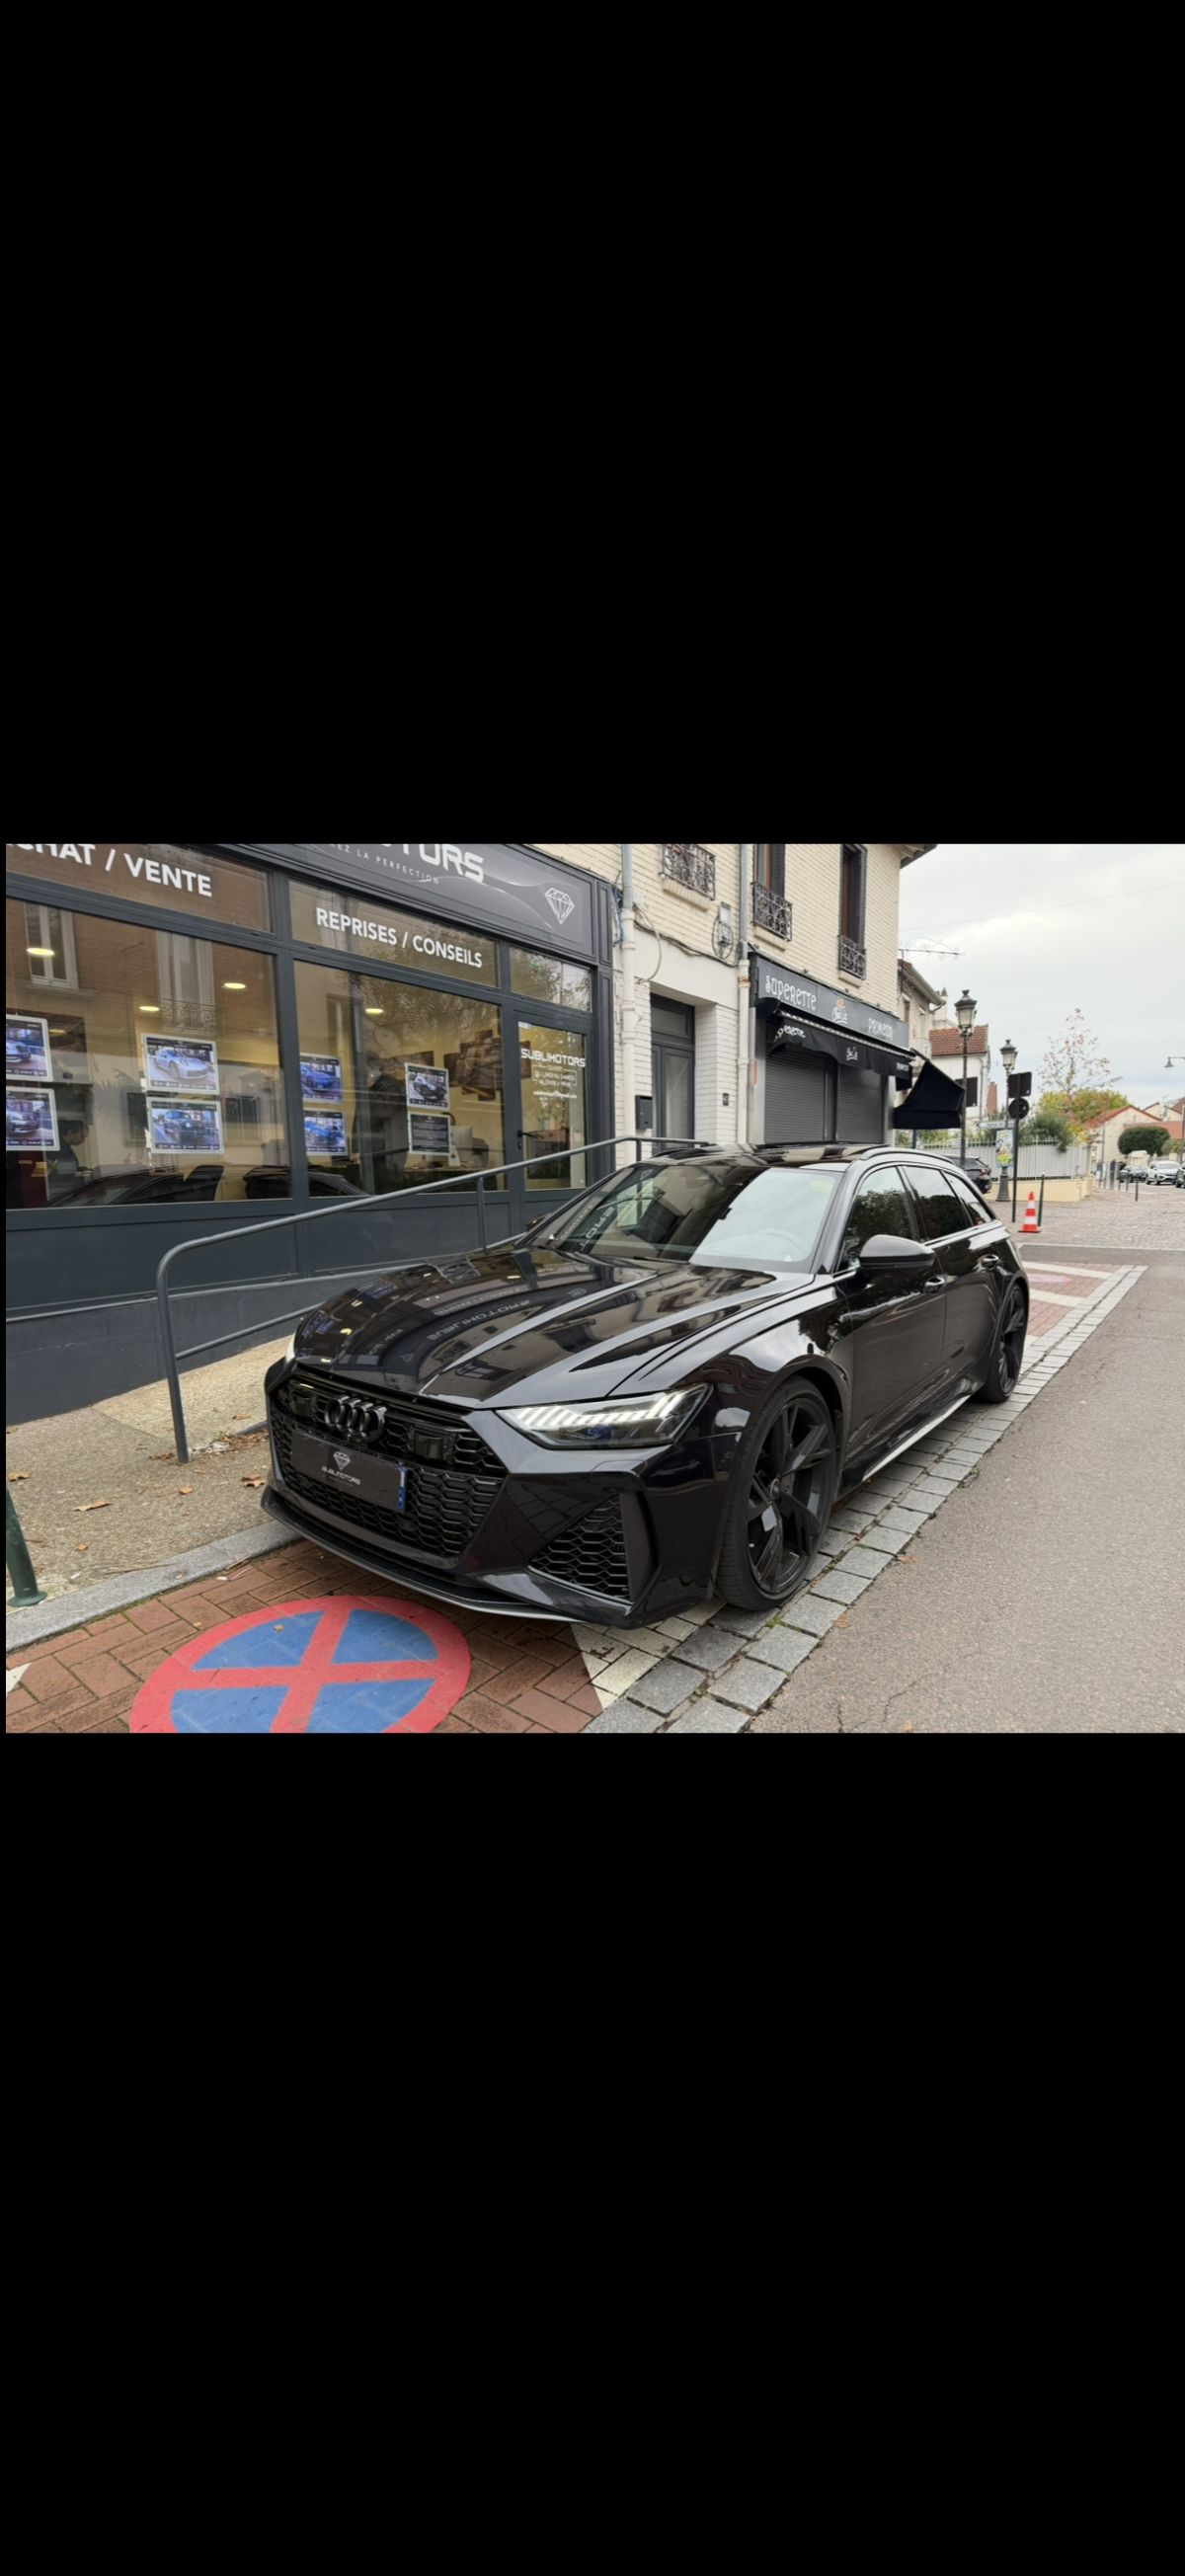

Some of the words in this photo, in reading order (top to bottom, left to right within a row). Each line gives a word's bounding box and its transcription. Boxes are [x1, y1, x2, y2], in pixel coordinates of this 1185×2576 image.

[123, 853, 212, 898] VENTE
[356, 850, 370, 860] LA
[375, 855, 439, 885] PERFECTION
[316, 907, 397, 946] REPRISES
[412, 935, 483, 969] CONSEILS
[520, 1048, 587, 1068] SUBLIMOTORS
